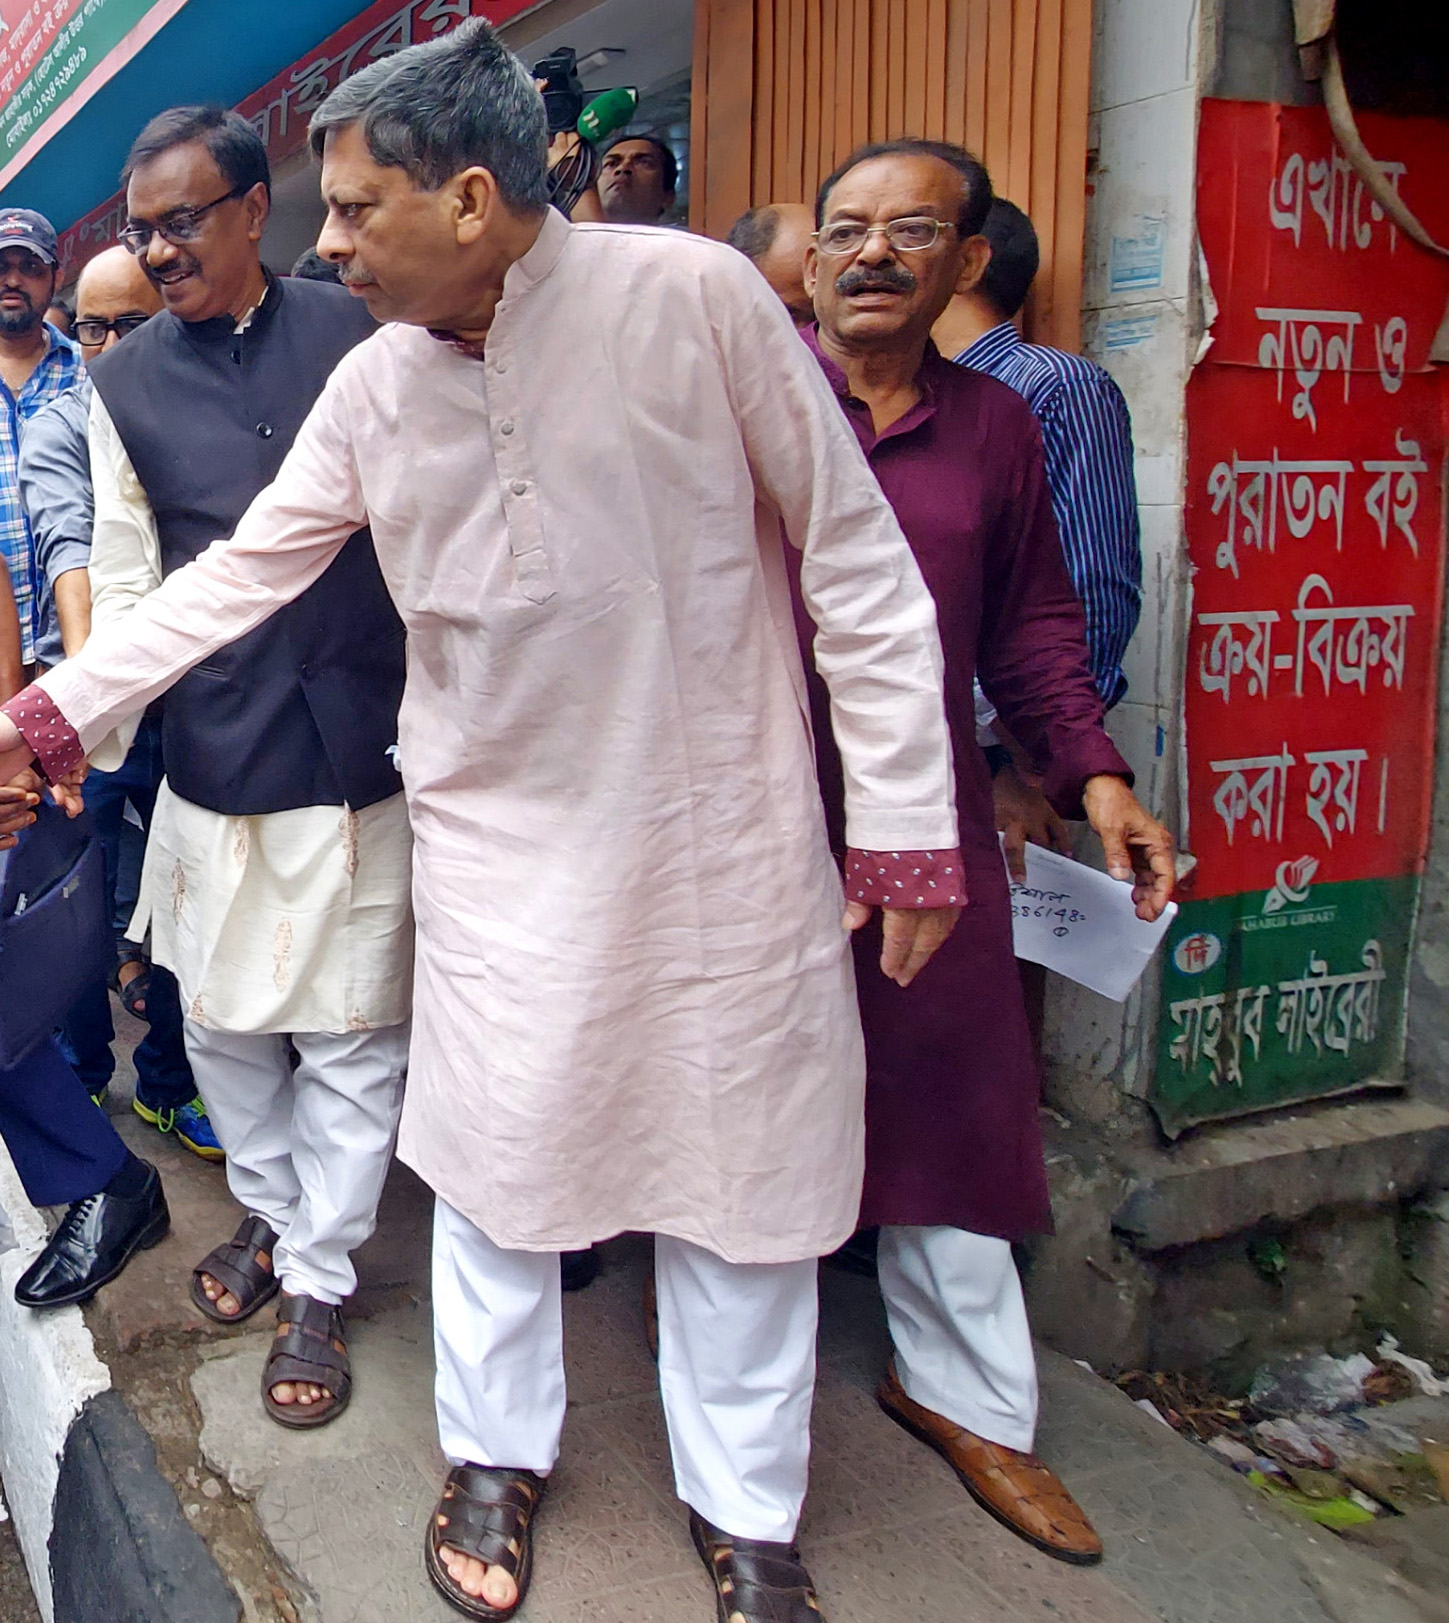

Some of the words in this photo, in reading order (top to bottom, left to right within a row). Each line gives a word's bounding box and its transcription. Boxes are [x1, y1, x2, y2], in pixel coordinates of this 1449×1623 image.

[1270, 148, 1408, 253] এখানে
[1255, 307, 1363, 434] নতুন
[1374, 316, 1407, 394] ও
[1207, 447, 1354, 580] পুরাতন
[1363, 427, 1428, 558] বই
[1198, 573, 1416, 704] ক্রয়-বিক্রয়
[1209, 741, 1296, 847] করা
